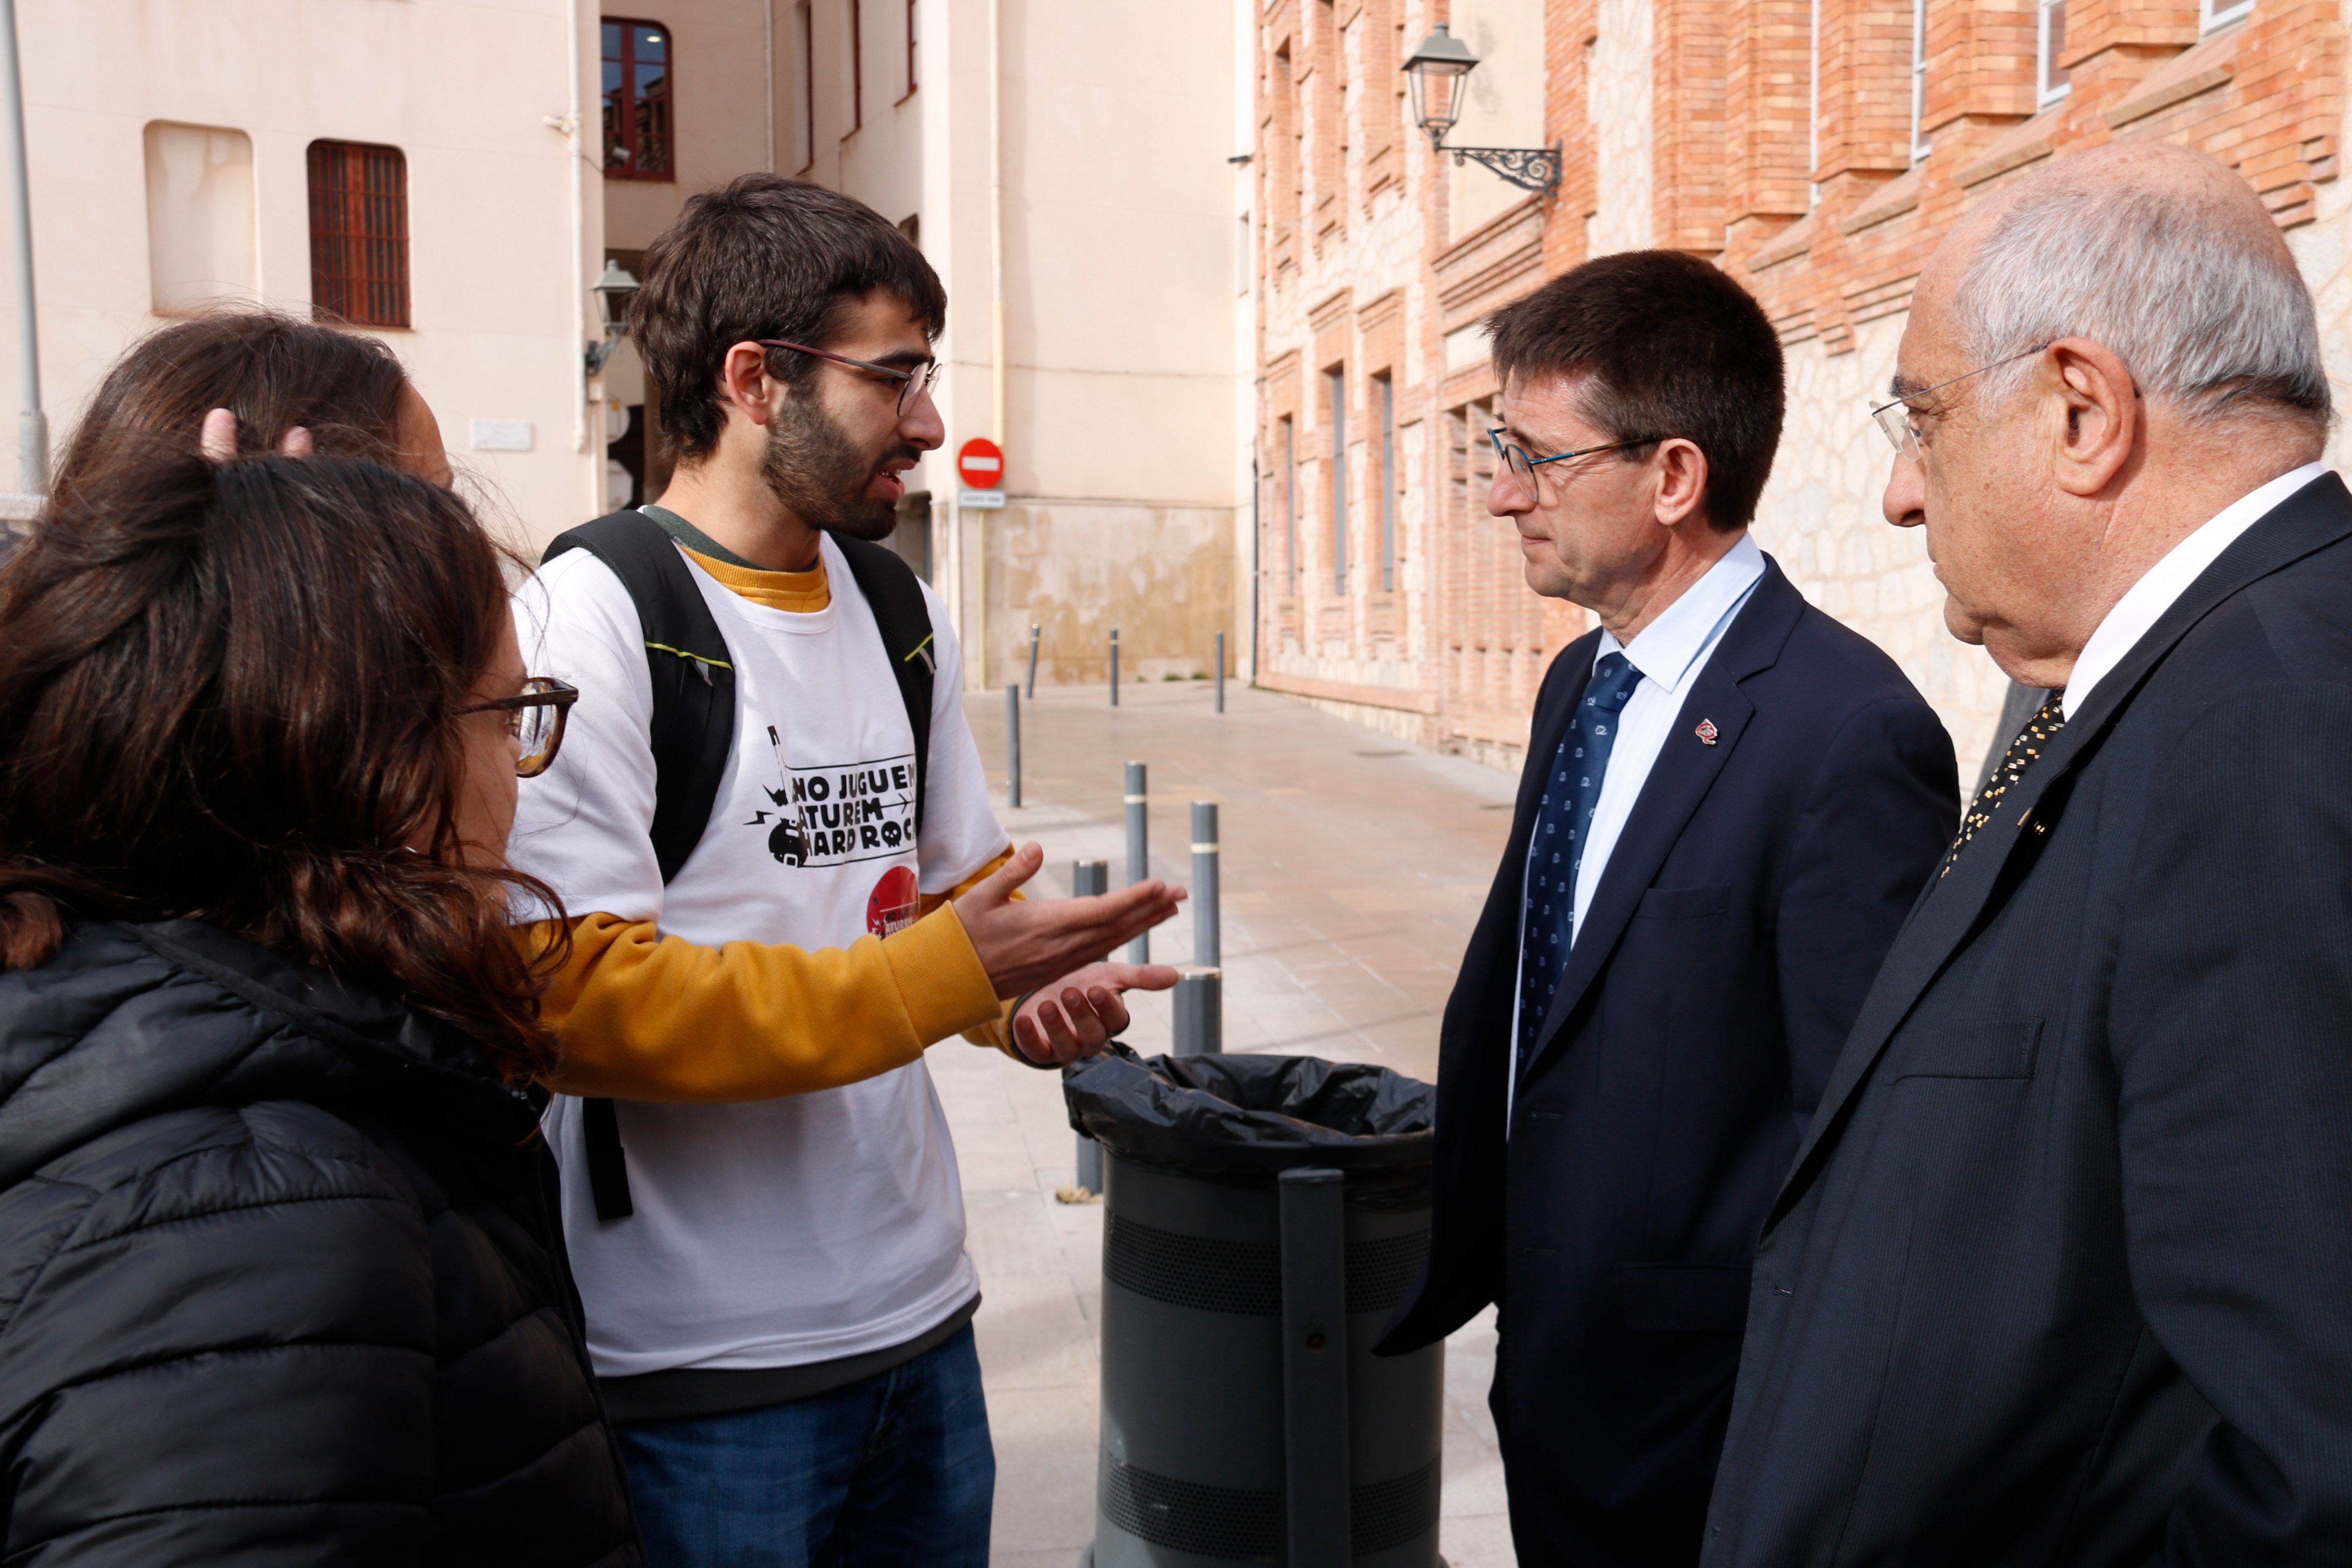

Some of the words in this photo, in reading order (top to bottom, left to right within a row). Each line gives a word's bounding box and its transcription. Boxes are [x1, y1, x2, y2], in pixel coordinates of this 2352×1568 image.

[792, 776, 830, 802] NO
[798, 797, 884, 829] ATUREM
[802, 829, 856, 856] HARD
